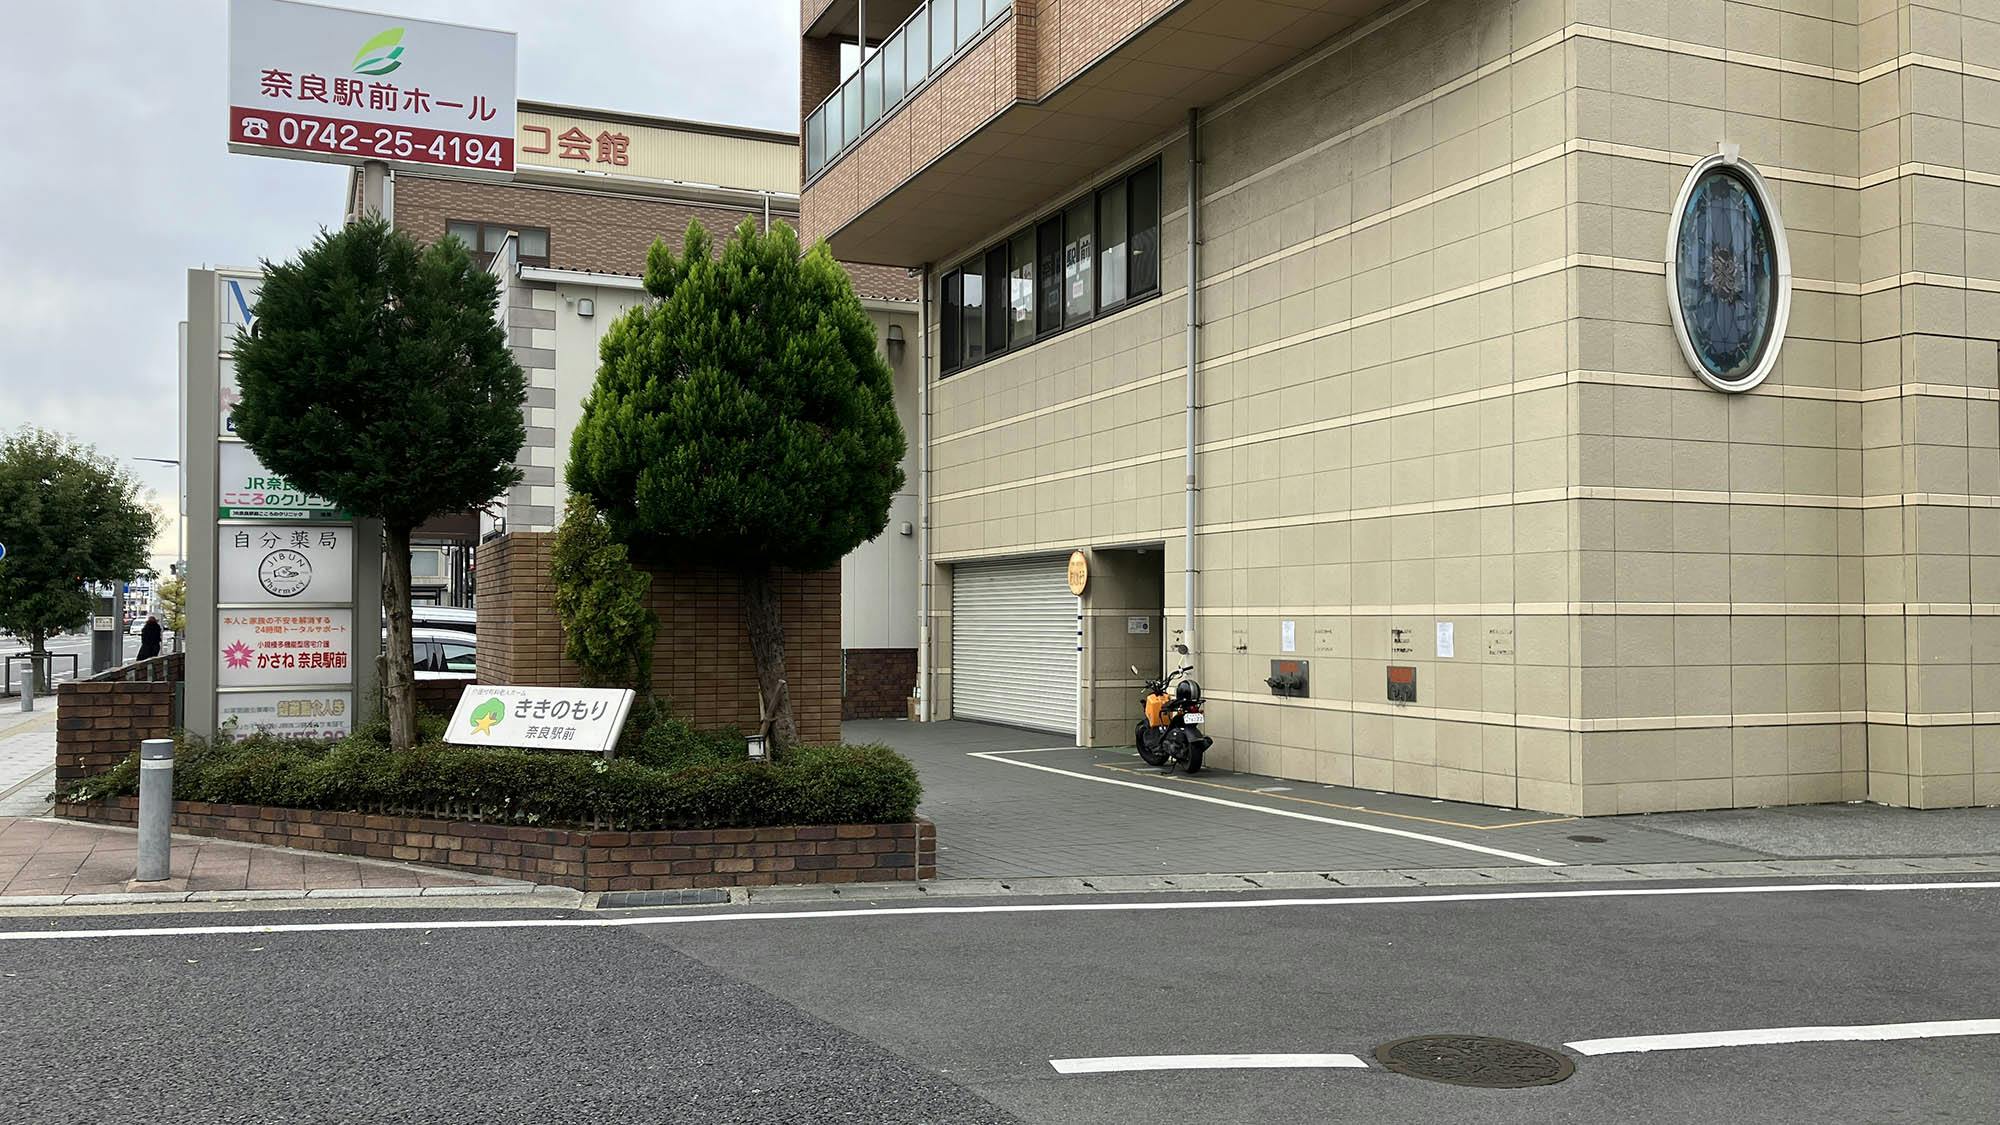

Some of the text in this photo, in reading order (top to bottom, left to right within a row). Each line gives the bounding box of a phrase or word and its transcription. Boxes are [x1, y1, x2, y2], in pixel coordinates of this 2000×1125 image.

[261, 69, 497, 121] 奈良駅前ホール
[279, 117, 502, 166] 0742-25-4194
[522, 125, 630, 166] コ会館
[235, 531, 337, 550] 自分薬局
[267, 553, 305, 568] JIBUN
[263, 578, 305, 594] Pharmacy
[223, 616, 331, 626] 本人と家族の不安を解消する
[255, 625, 347, 634] 24時間トータルサポート
[257, 640, 330, 649] 小規模多機能型居宅介護
[257, 652, 347, 669] かさね 奈良駅前
[514, 699, 608, 721] ききのもり
[525, 726, 577, 741] 奈良駅前
